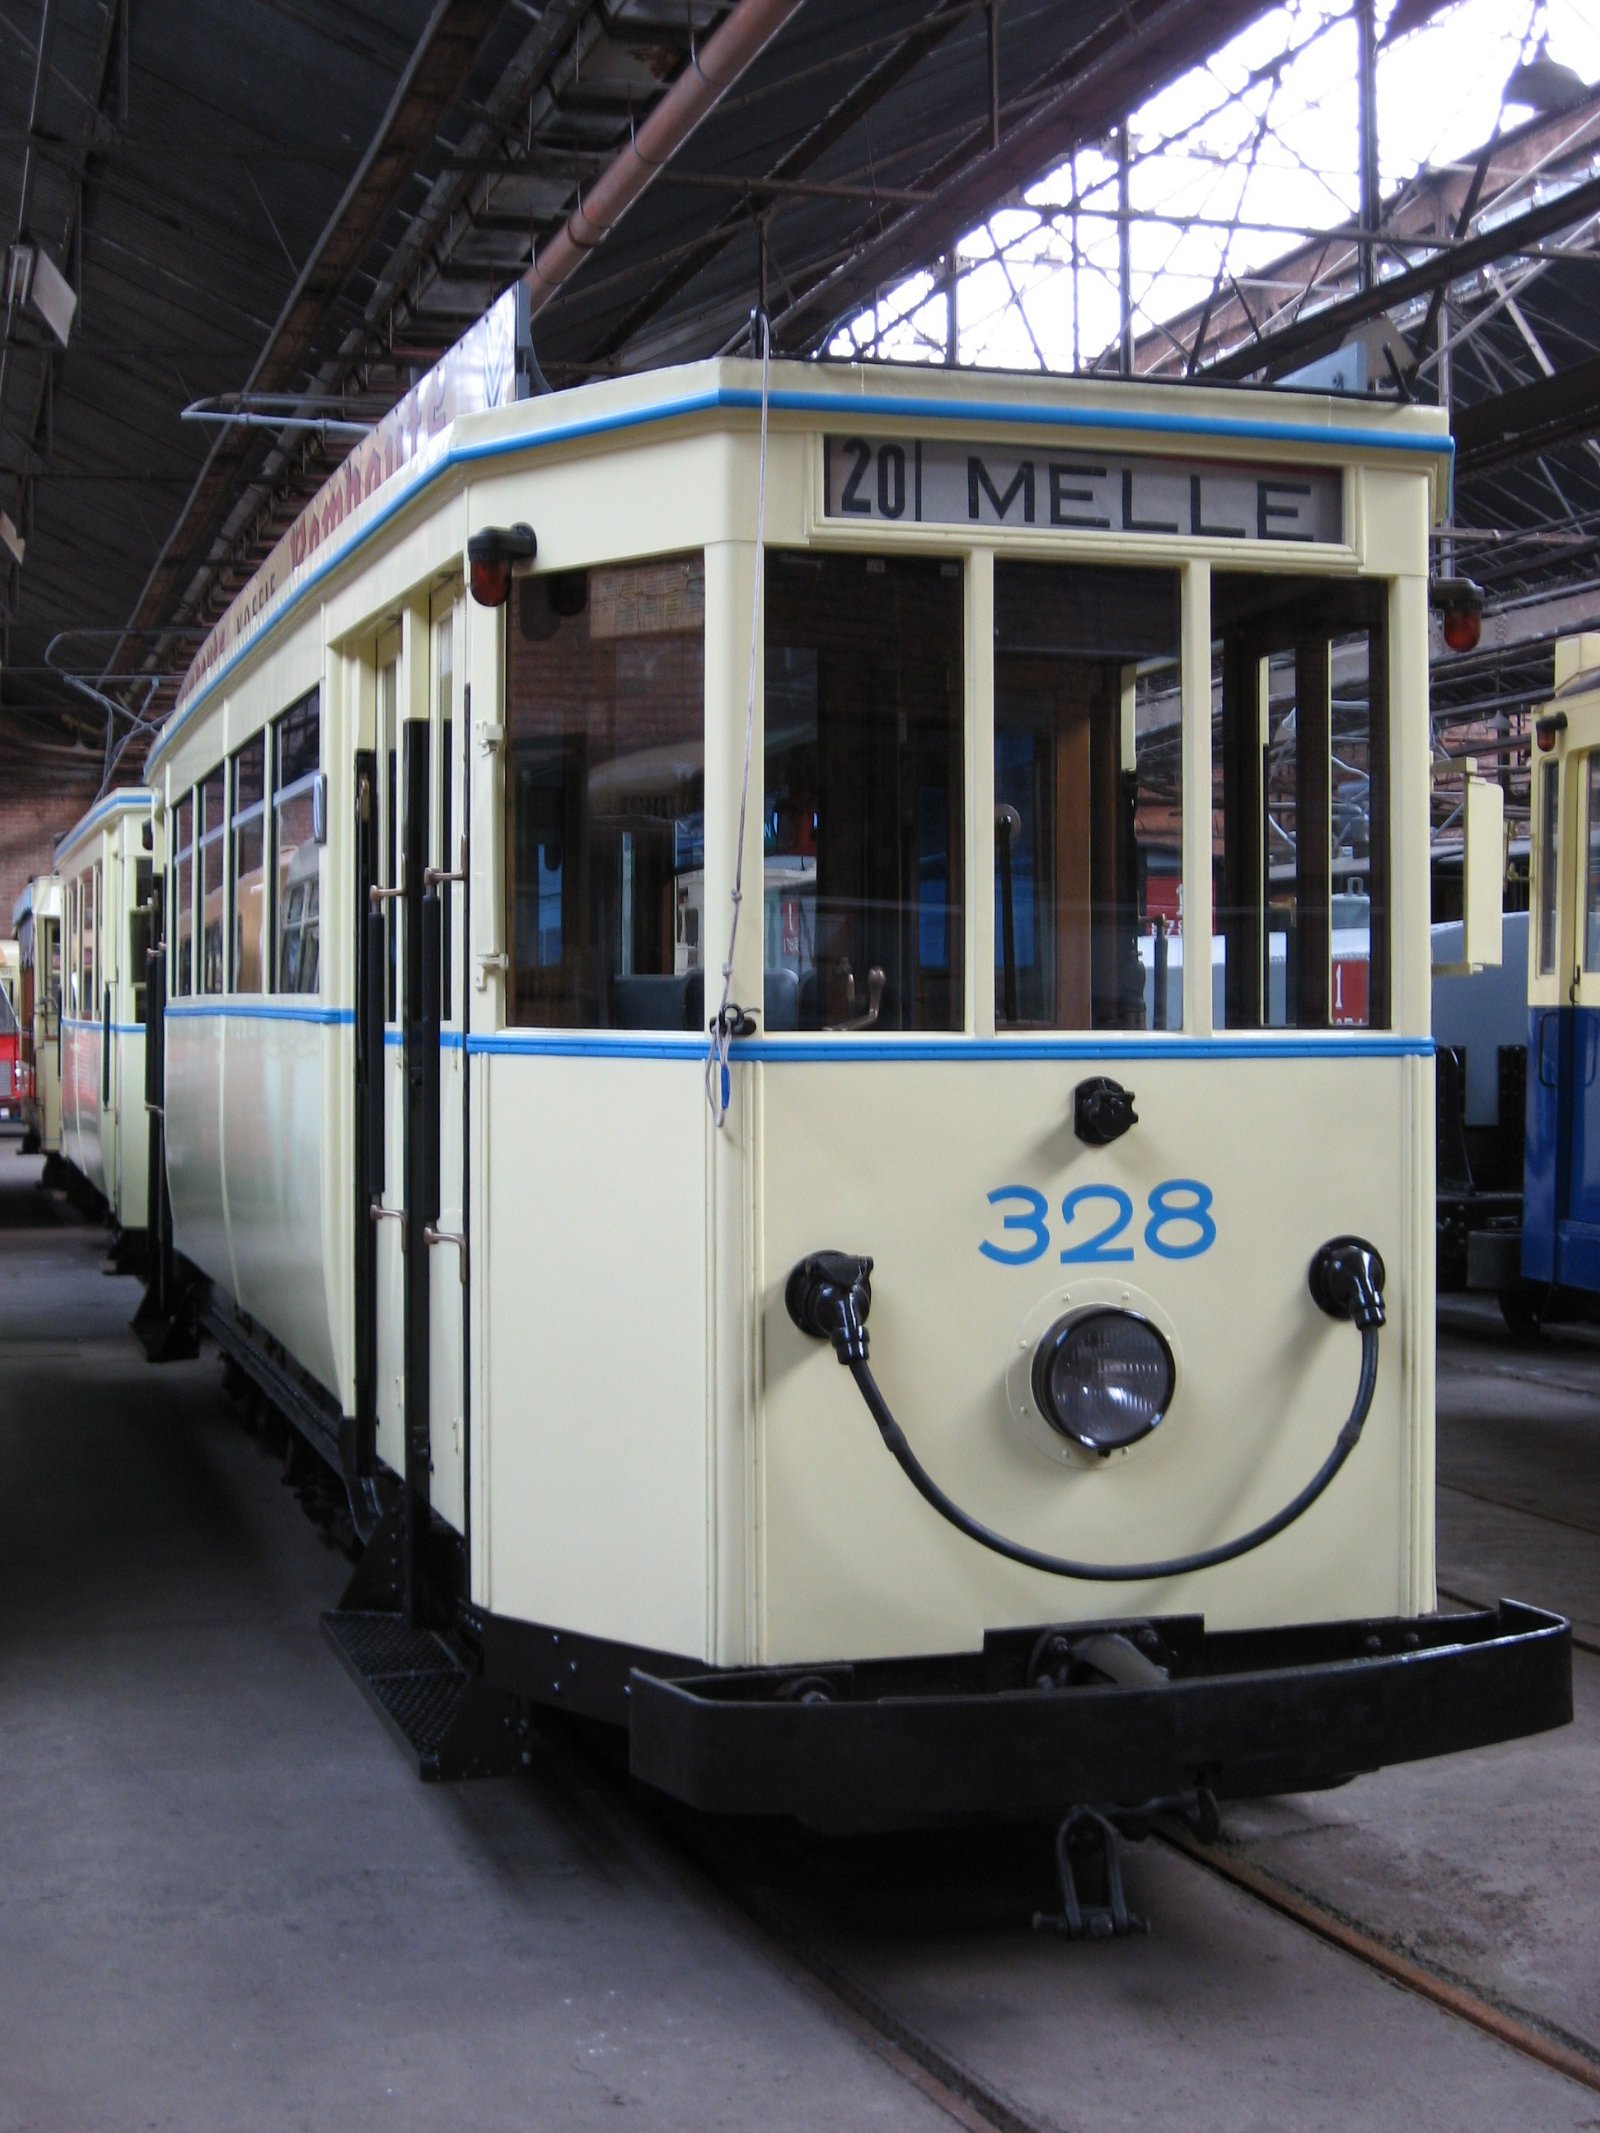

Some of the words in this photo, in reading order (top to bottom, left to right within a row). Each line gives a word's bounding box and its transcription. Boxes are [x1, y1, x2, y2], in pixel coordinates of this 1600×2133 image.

[840, 436, 906, 519] 20
[967, 455, 1315, 543] MELLE
[977, 1177, 1217, 1266] 328
